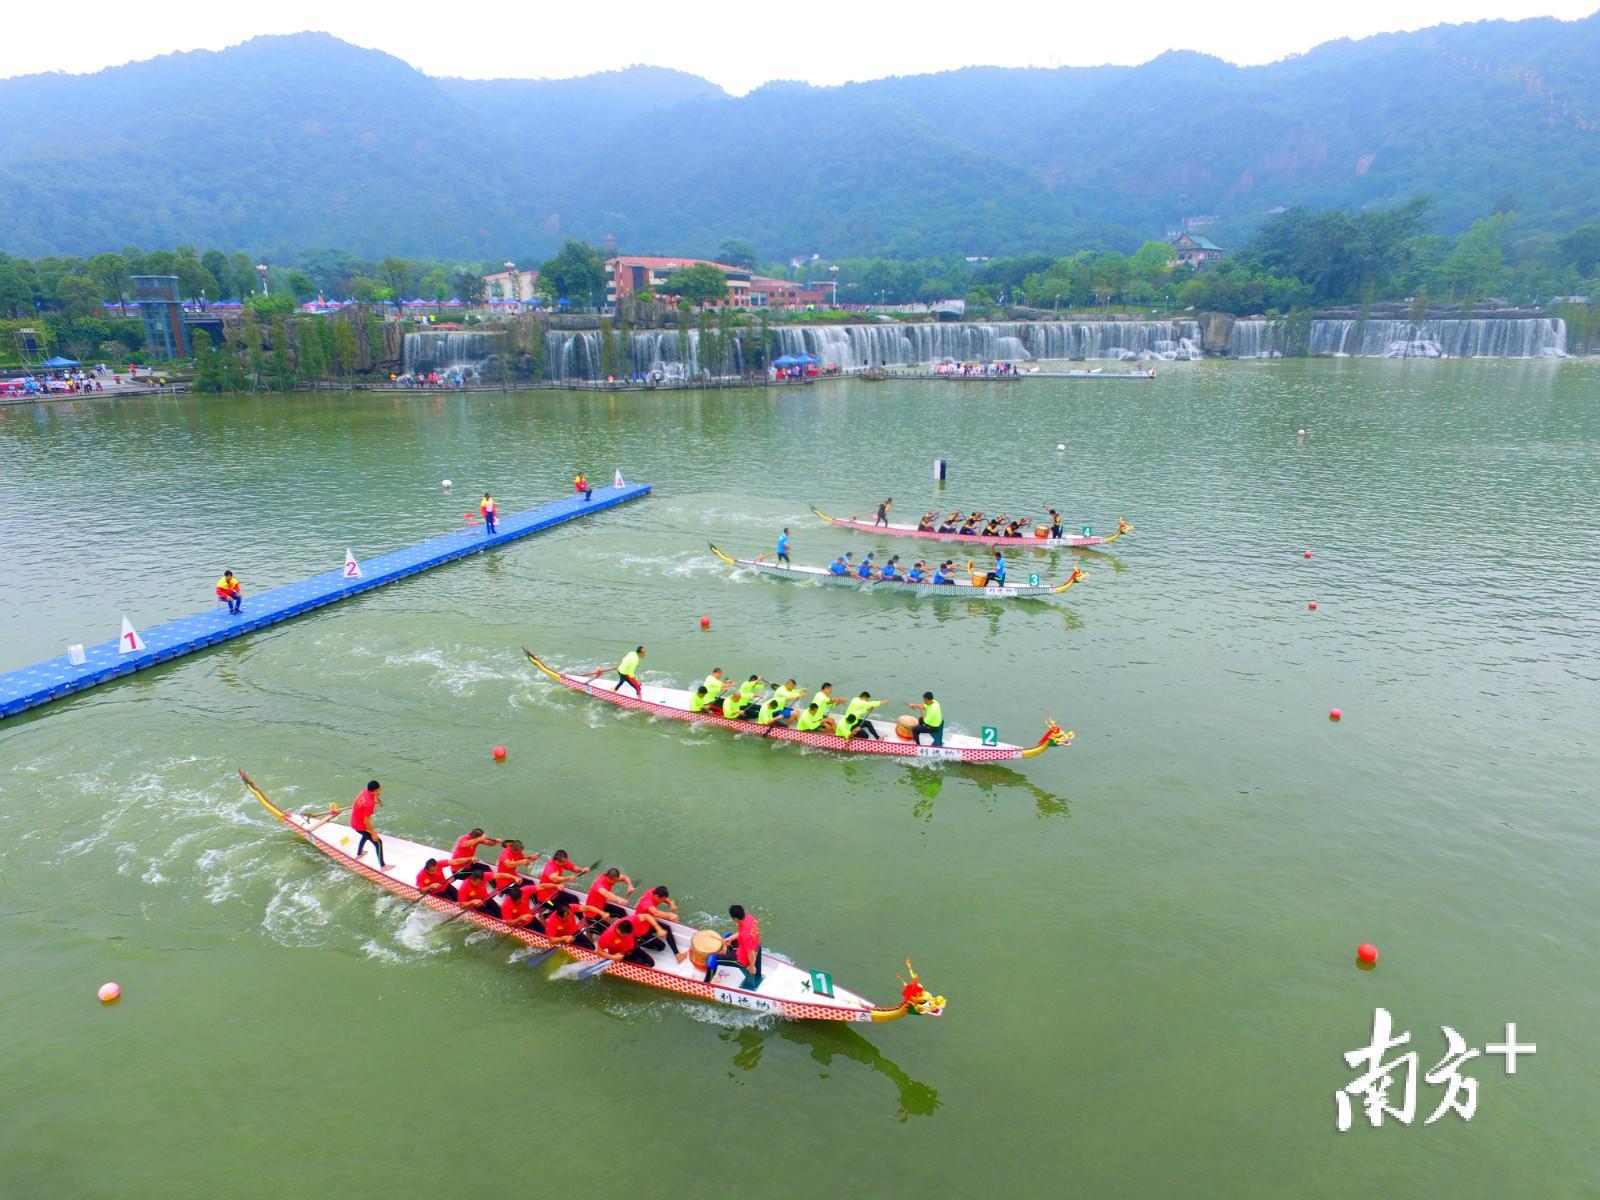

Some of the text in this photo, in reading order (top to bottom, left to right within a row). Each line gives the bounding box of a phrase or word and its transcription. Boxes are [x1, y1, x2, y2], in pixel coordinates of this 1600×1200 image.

[1083, 527, 1091, 537] 4
[346, 561, 358, 576] 2
[1030, 574, 1038, 586] 3
[124, 631, 137, 649] 1
[984, 728, 996, 746] 2
[815, 973, 829, 994] 1
